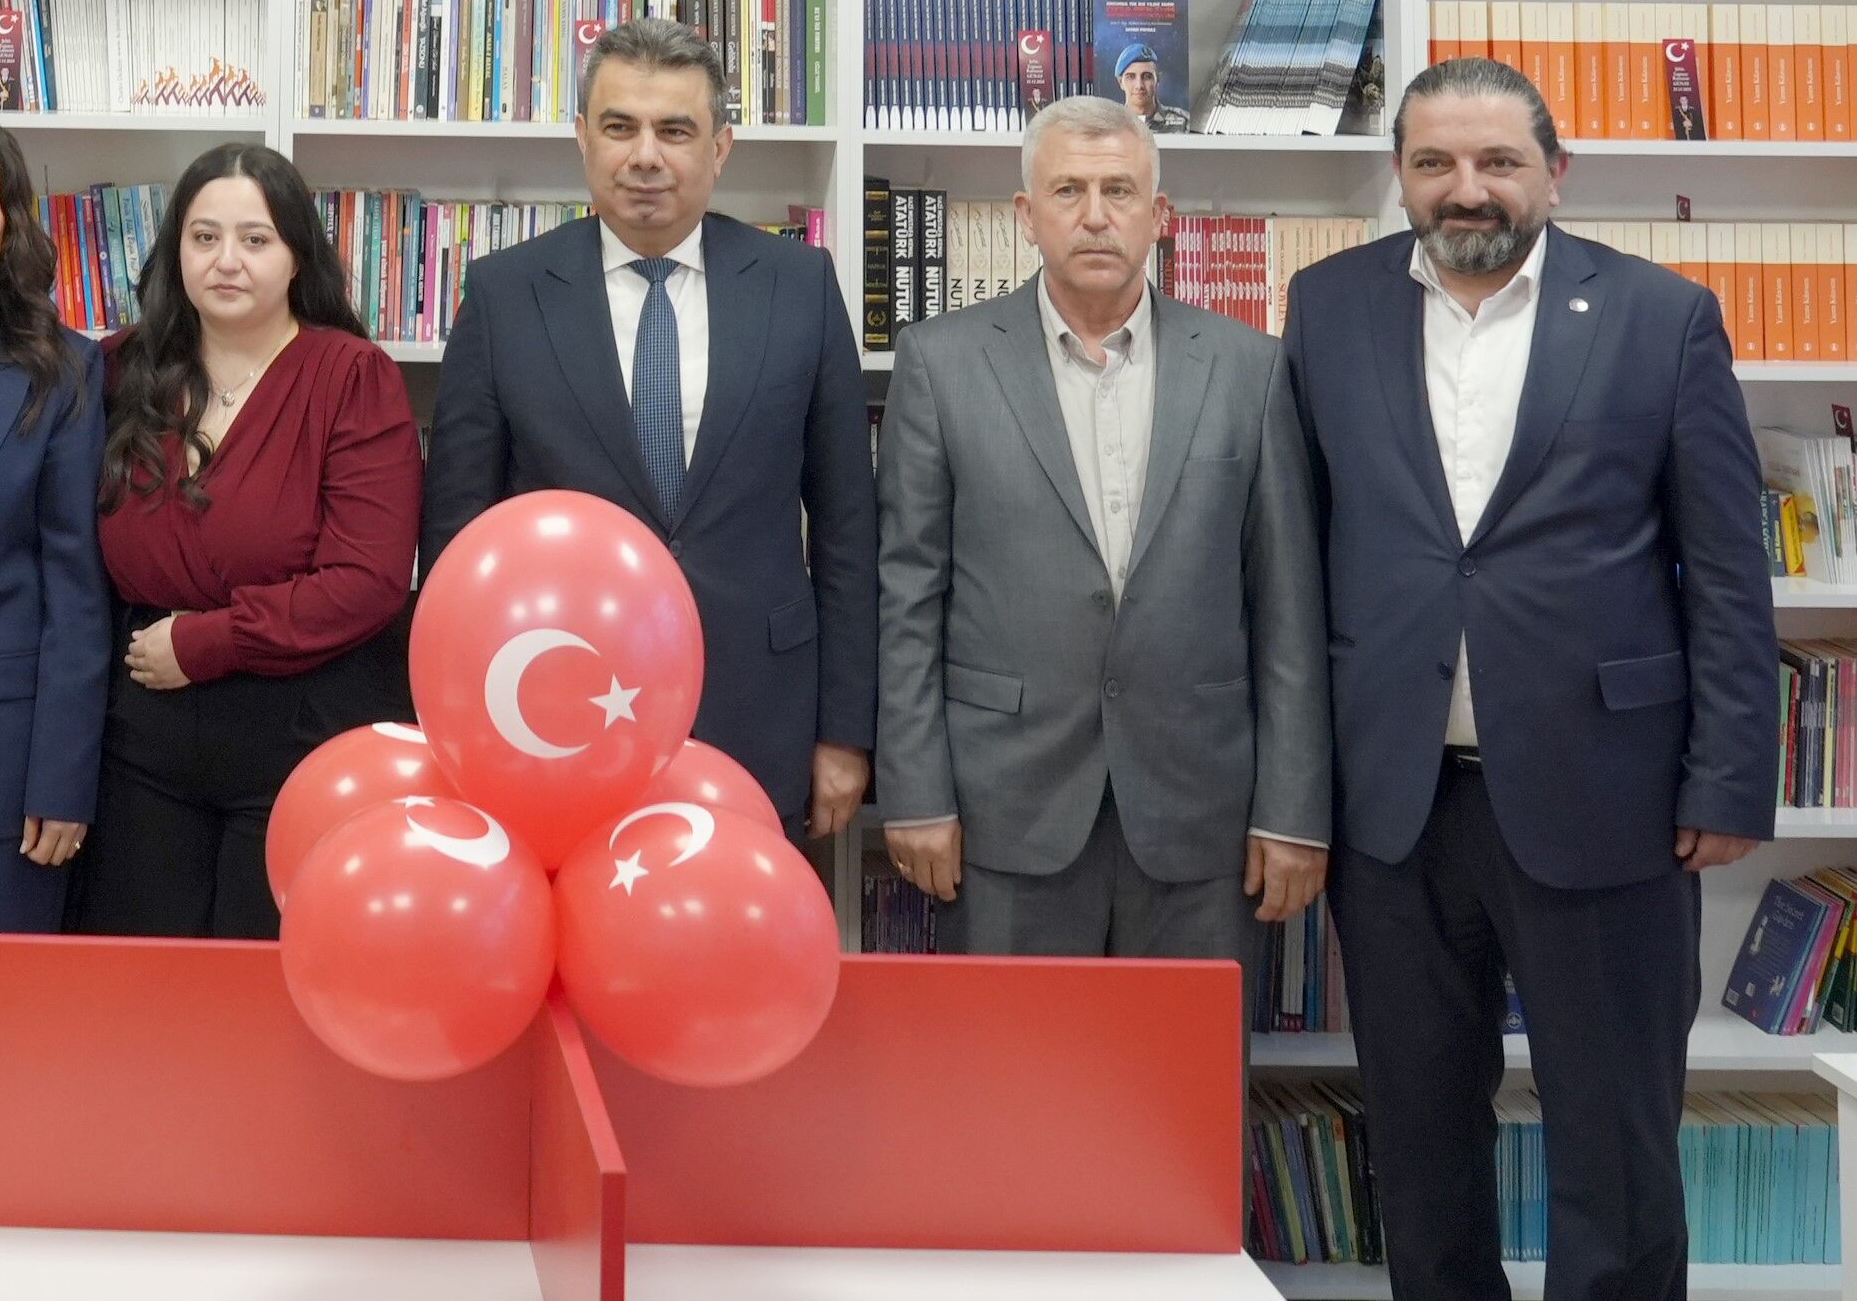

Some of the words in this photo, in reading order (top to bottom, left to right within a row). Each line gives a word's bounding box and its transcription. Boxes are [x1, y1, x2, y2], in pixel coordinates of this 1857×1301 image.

[895, 195, 909, 259] ATATÜRK
[925, 195, 938, 259] ATATÜRK
[896, 266, 910, 322] NUTUK
[926, 266, 939, 320] NUTUK
[951, 278, 962, 309] NUT
[1164, 259, 1173, 298] NUTU
